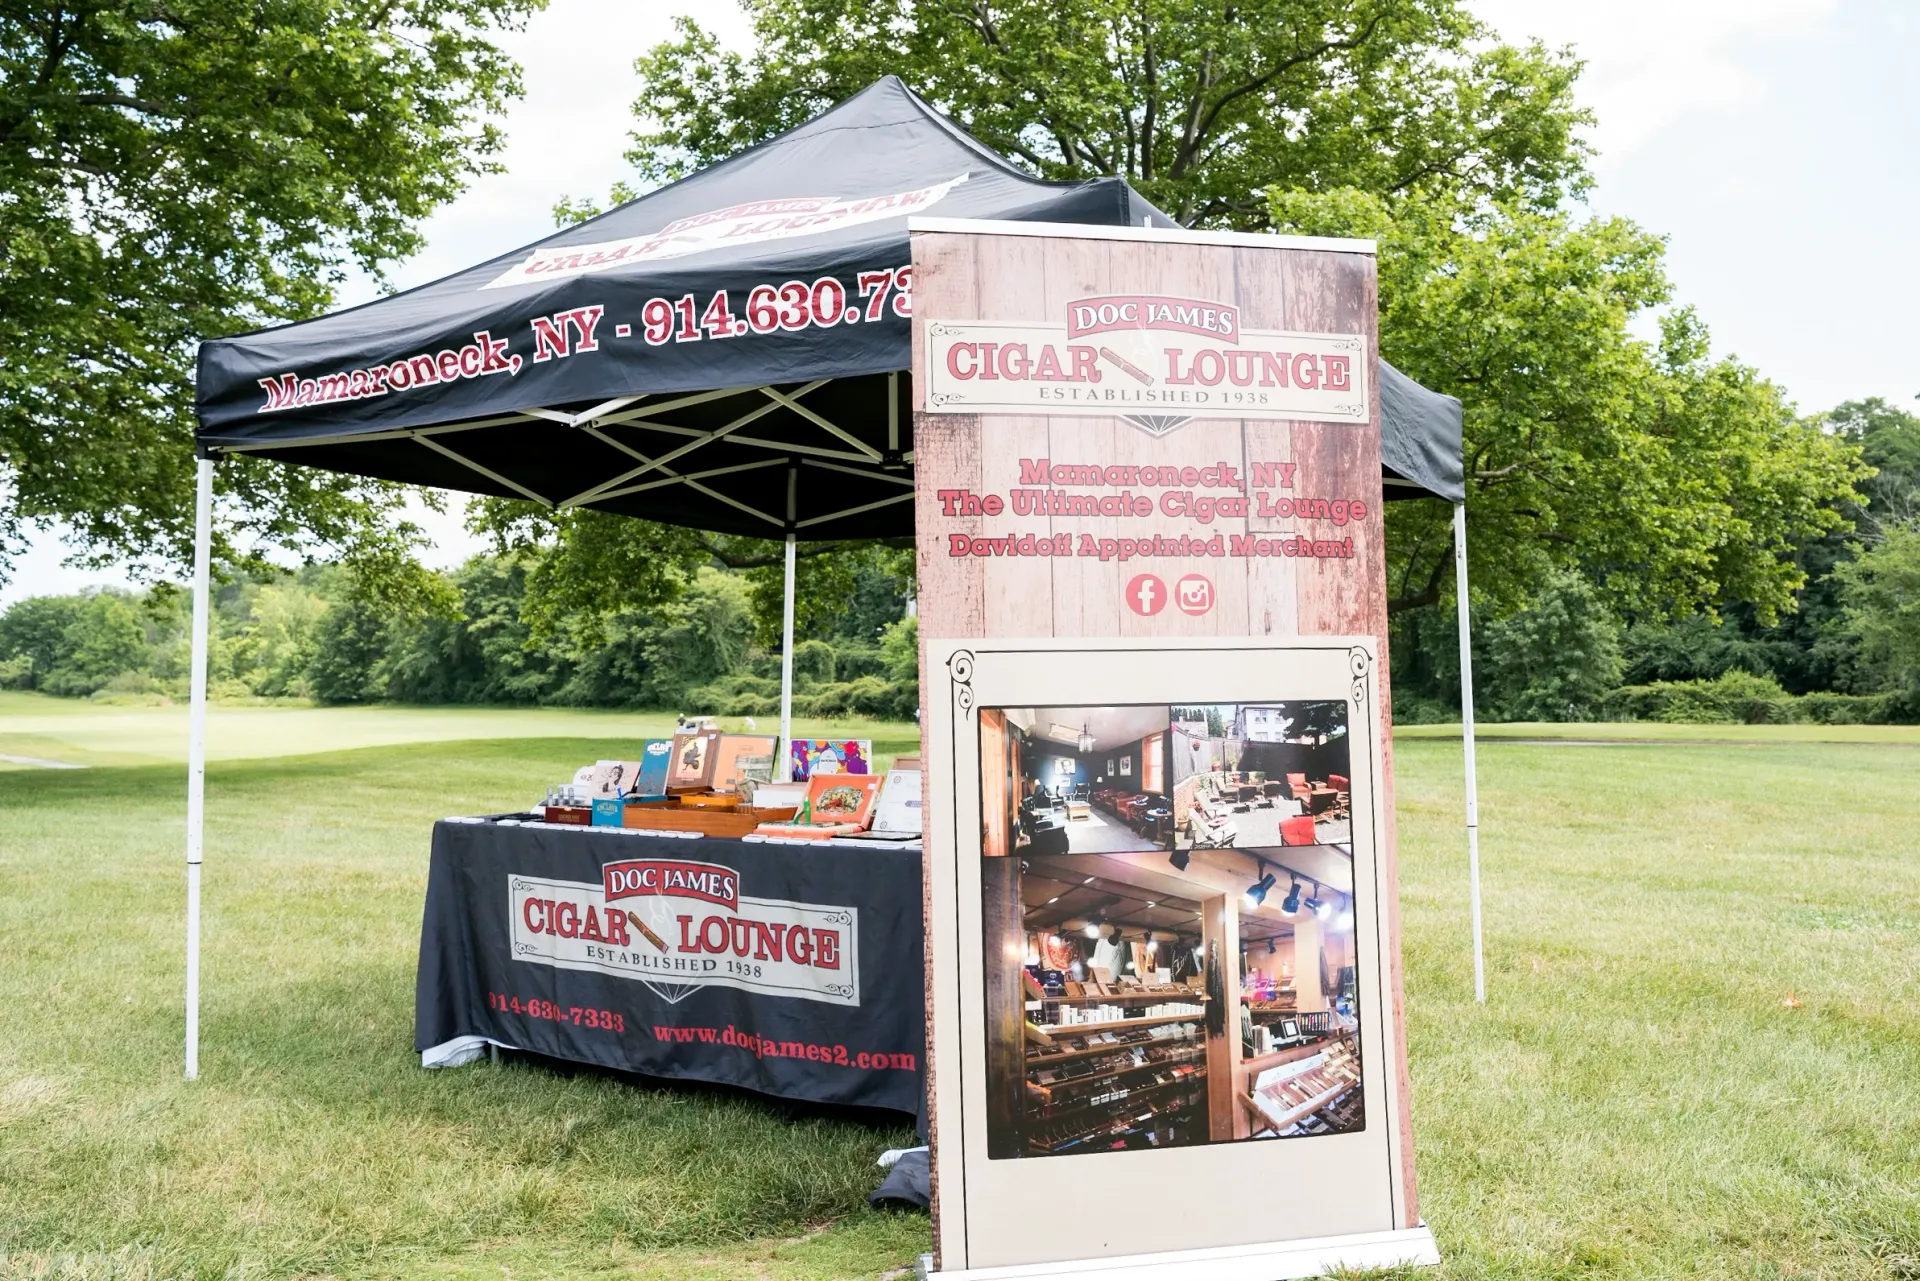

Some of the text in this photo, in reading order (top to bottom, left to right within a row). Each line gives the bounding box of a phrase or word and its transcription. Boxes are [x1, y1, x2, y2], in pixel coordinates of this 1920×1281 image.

[1073, 303, 1233, 336] DOC JAMES
[257, 330, 523, 413] Mamaroneck,
[530, 304, 604, 364] NY
[947, 341, 1350, 392] CIGAR LOUNGE
[1039, 387, 1269, 405] ESTABLISHED 1938
[1019, 458, 1296, 492] Mamaroneck, NY
[937, 489, 1368, 526] The Ultimate Cigar Lounge
[949, 533, 1354, 562] Davidoff Appointed Merchant
[609, 867, 735, 901] DOC JAMES
[523, 897, 840, 970] CIGAR LOUNGE
[587, 945, 762, 978] ESTABLISHED 1938
[653, 1024, 916, 1071] www.docjames2.com
